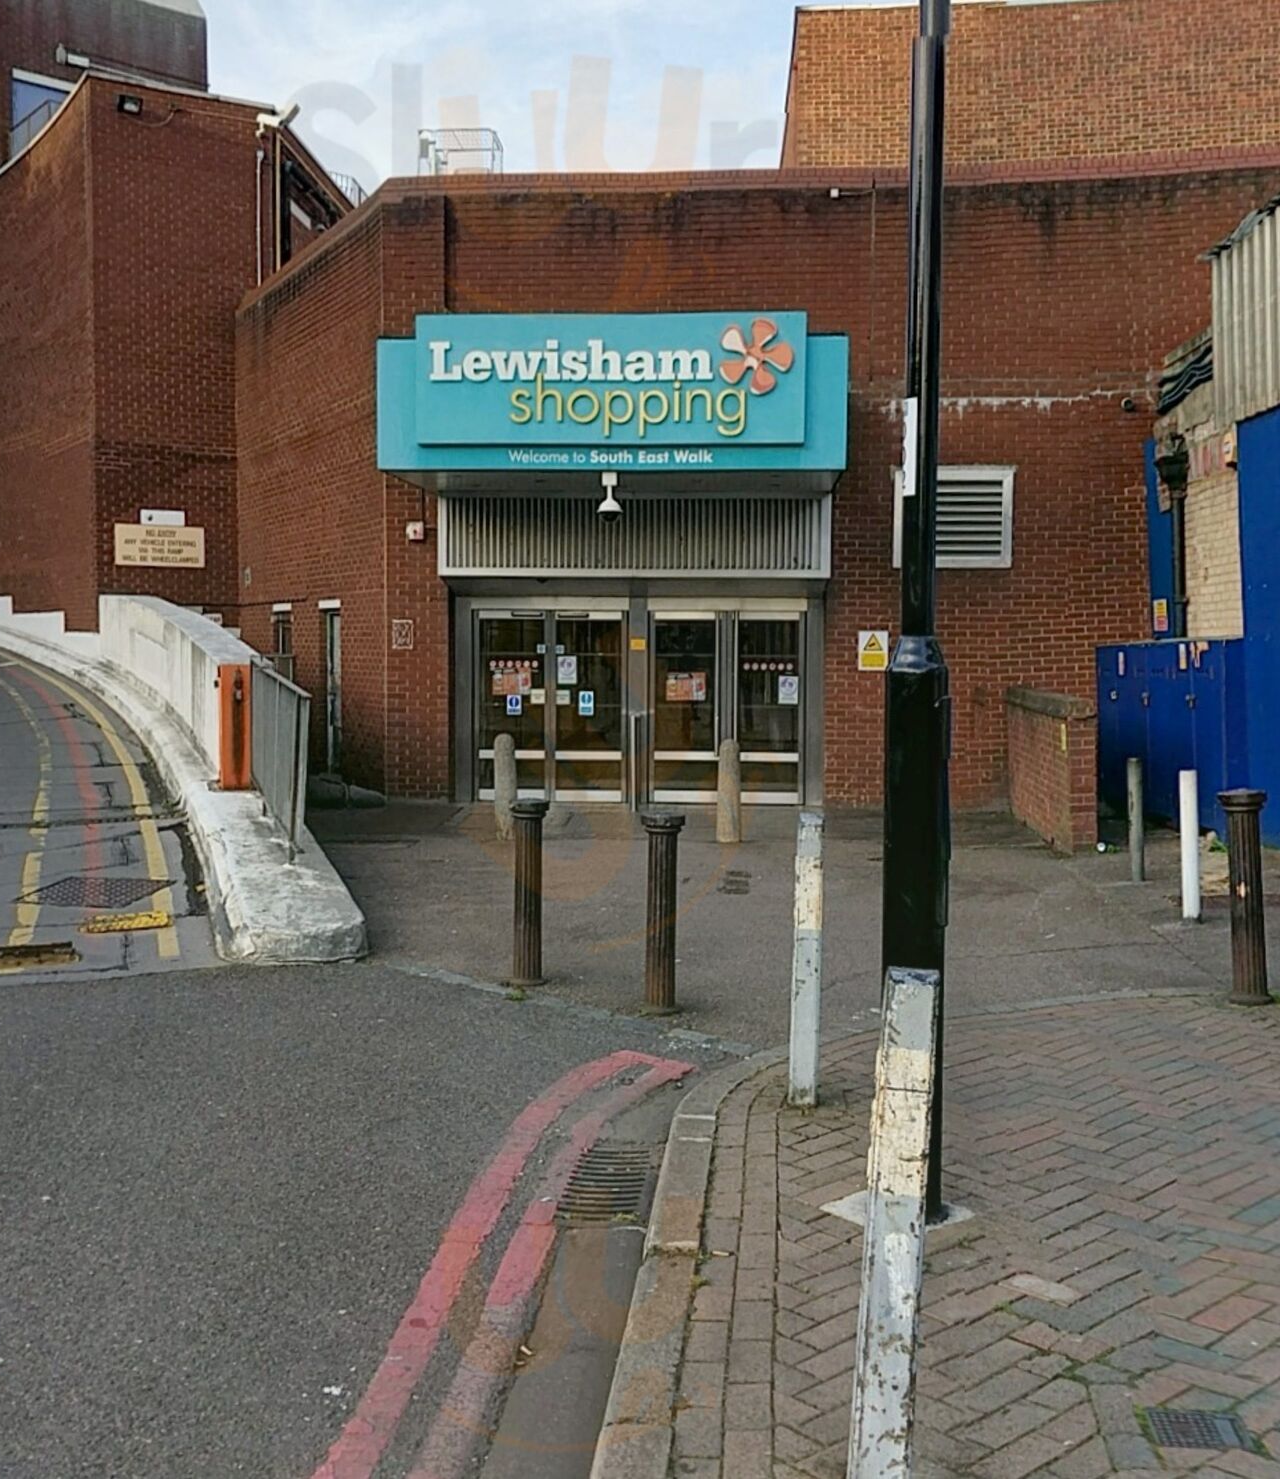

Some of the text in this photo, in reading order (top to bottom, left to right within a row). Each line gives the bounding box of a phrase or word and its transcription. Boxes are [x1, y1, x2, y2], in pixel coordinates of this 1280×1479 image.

[428, 339, 714, 382] Lewisham
[509, 373, 748, 438] shopping
[508, 449, 714, 464] Welcome to South East Walk
